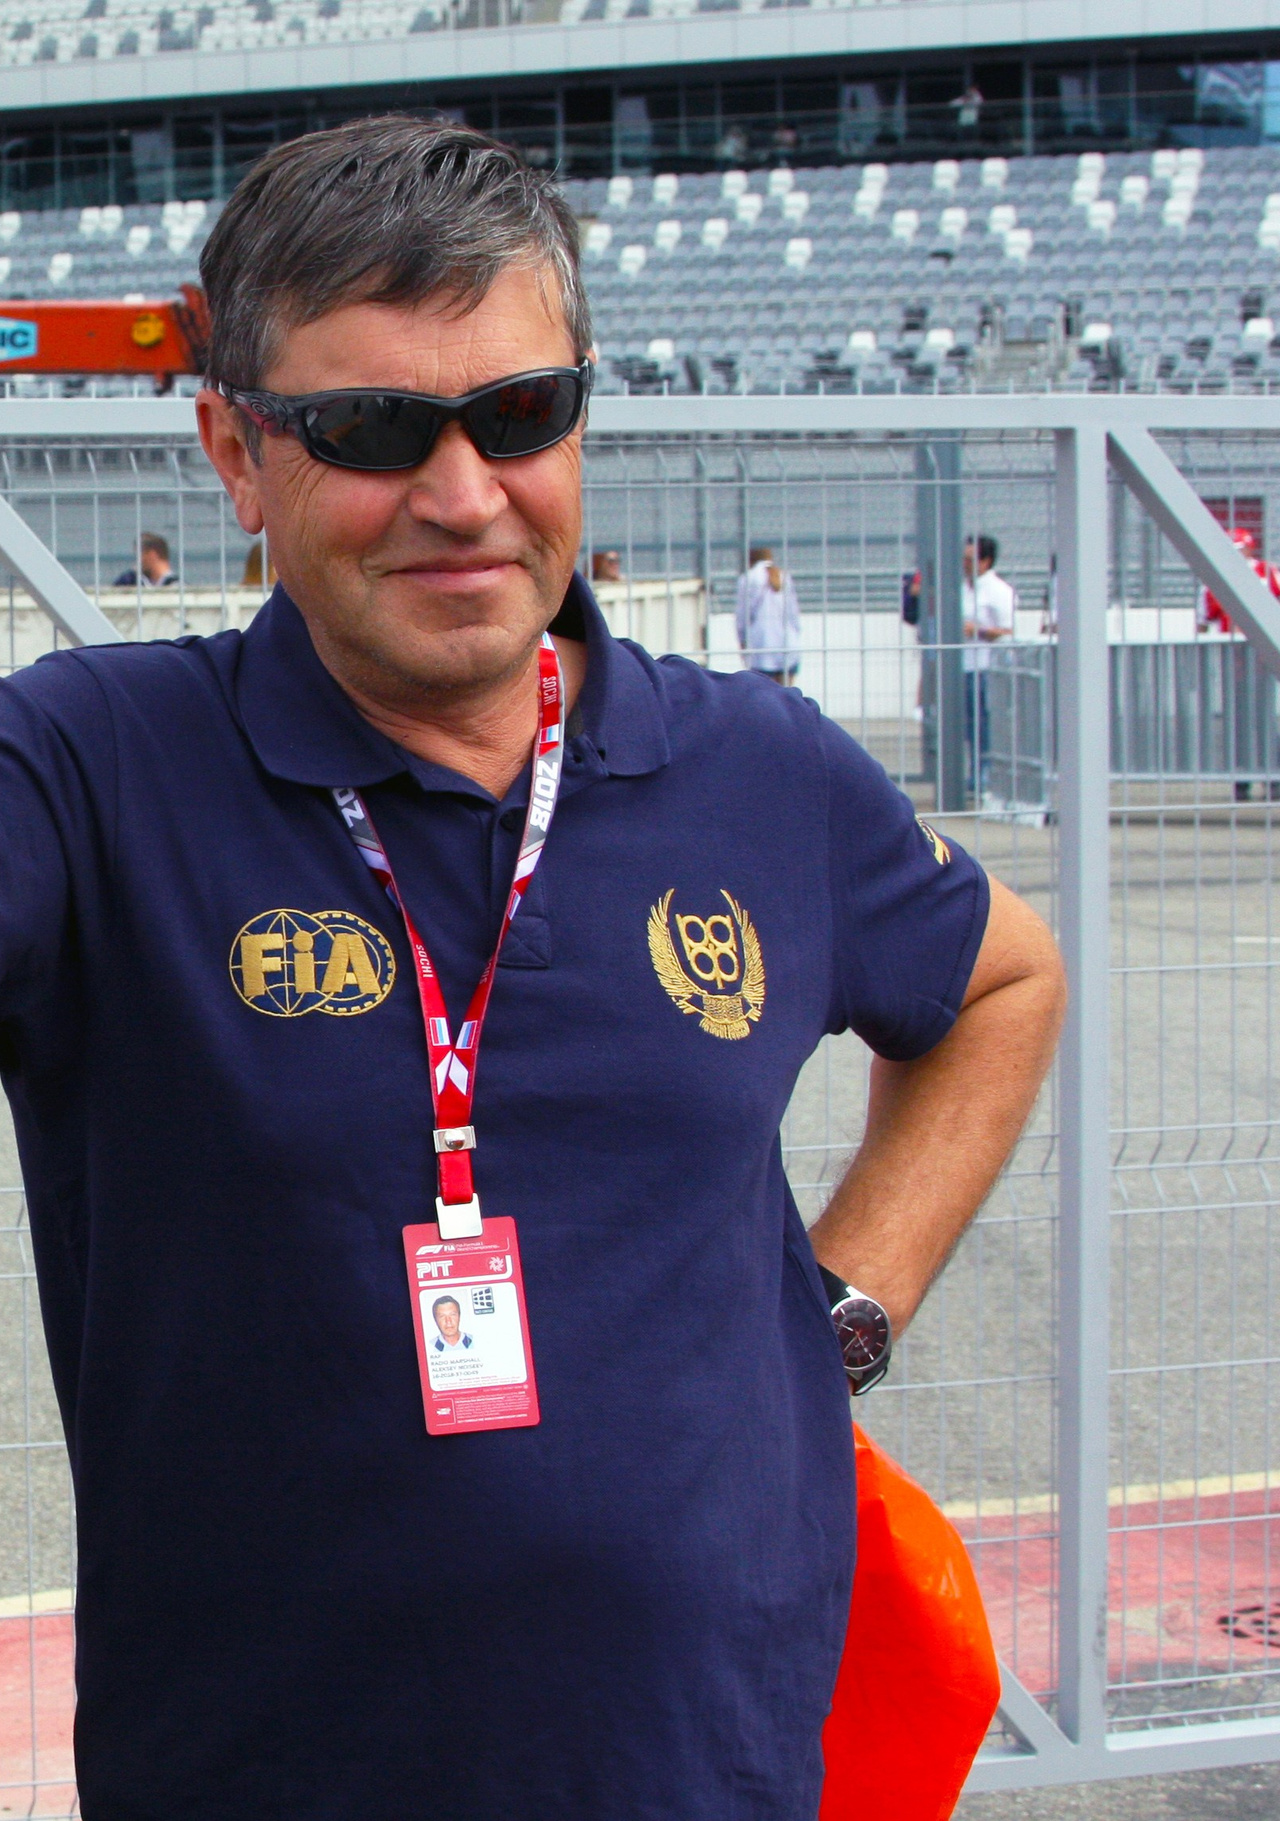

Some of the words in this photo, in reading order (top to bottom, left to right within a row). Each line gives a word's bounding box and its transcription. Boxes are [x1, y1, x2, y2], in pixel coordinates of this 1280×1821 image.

[542, 675, 557, 706] SOCHI
[529, 759, 559, 832] 2018
[415, 944, 434, 978] SOCHI
[416, 1260, 453, 1279] PIT
